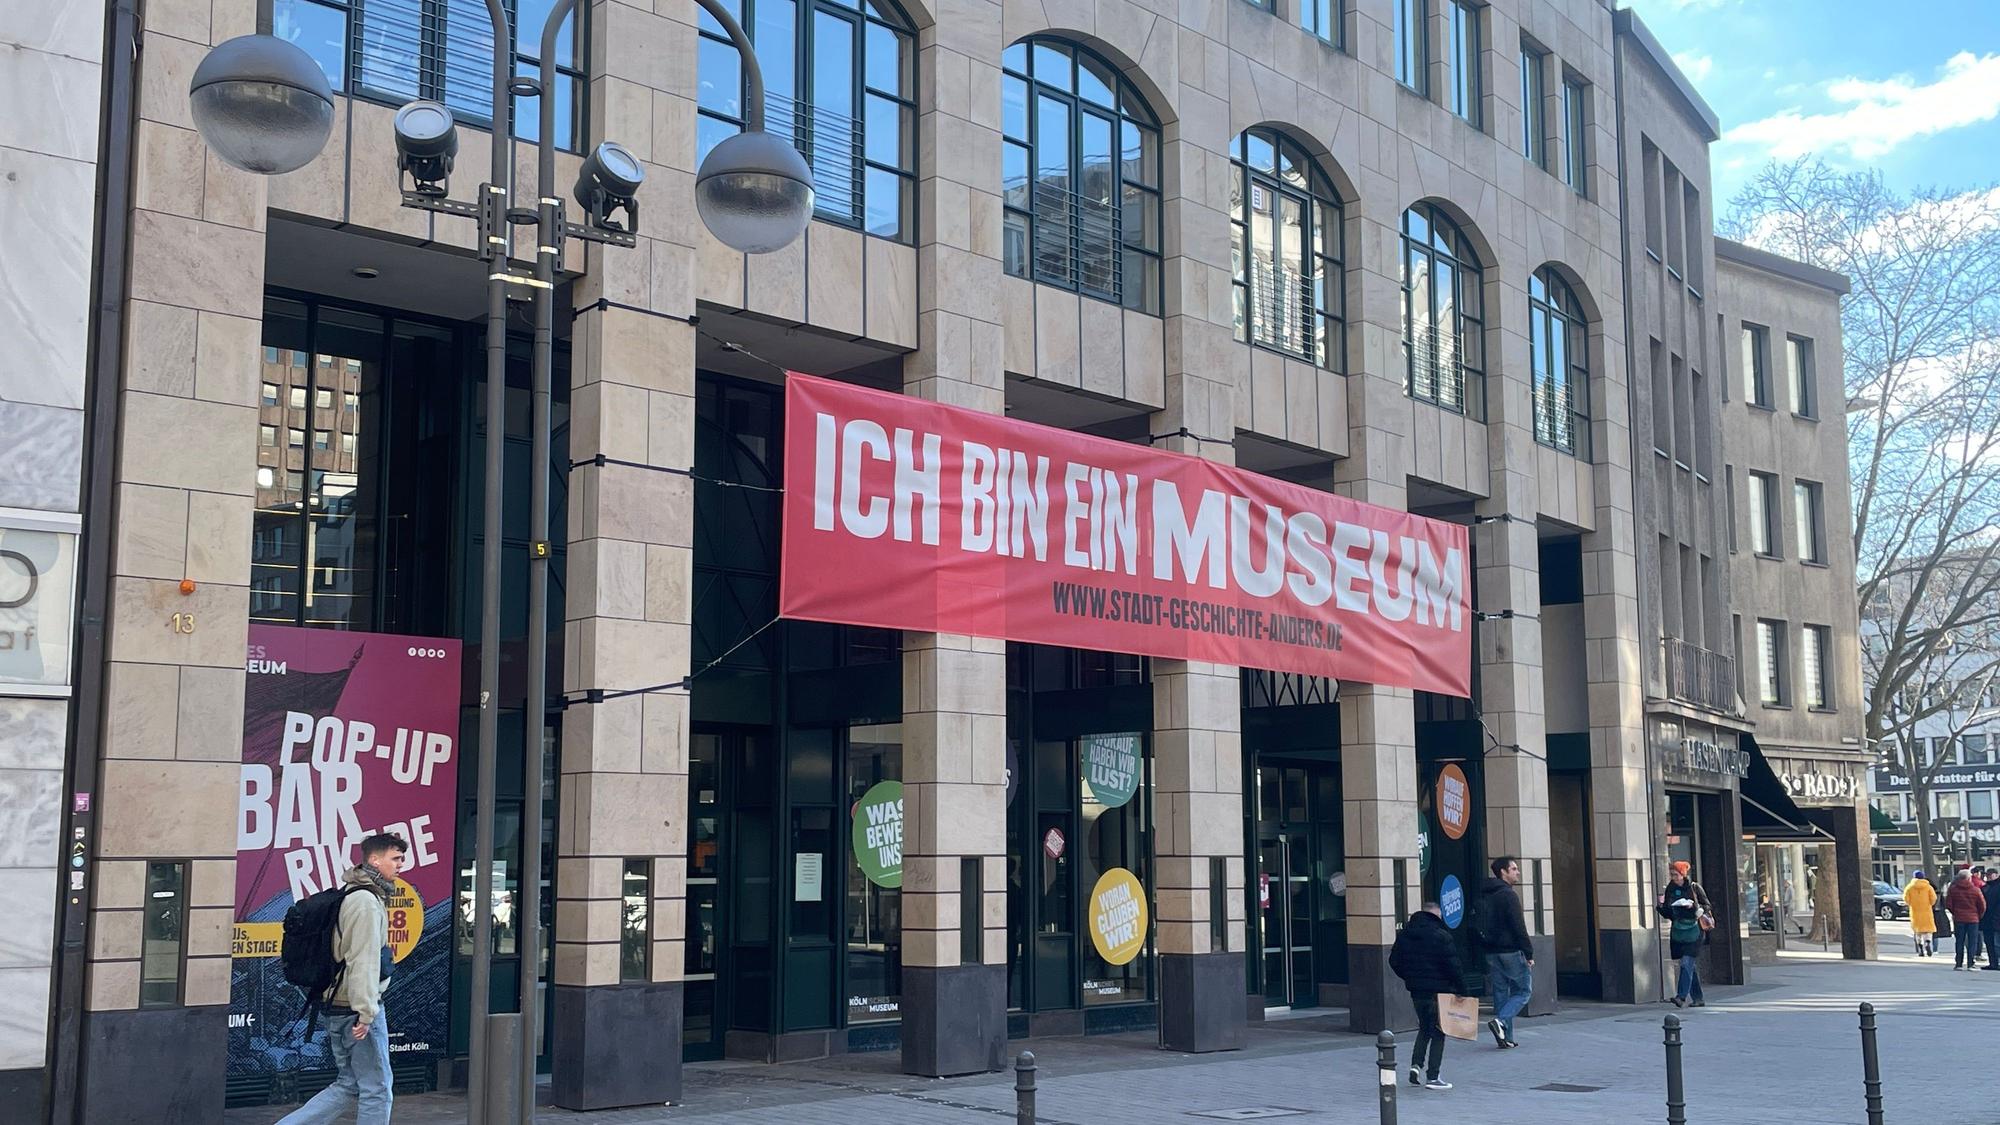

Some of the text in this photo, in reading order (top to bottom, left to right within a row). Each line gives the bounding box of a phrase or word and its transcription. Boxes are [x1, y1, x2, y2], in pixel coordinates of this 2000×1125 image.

[814, 412, 1463, 632] ICH BIN EIN MUSEUM
[537, 543, 545, 555] 5
[172, 612, 194, 634] 13
[1053, 581, 1343, 651] WWW.STADT-GESCHICHTE-ANDERS.DE
[279, 710, 453, 786] POP-UP
[1090, 743, 1136, 775] HABEN WIR
[1091, 764, 1132, 793] LUST?
[1975, 771, 1995, 783] für
[237, 762, 364, 850] BAR
[284, 815, 438, 903] RIKDE
[1097, 898, 1140, 935] GLAUBEN
[246, 940, 278, 954] STAGE
[1104, 919, 1138, 951] WIR?
[390, 1042, 429, 1052] Stadt Köln
